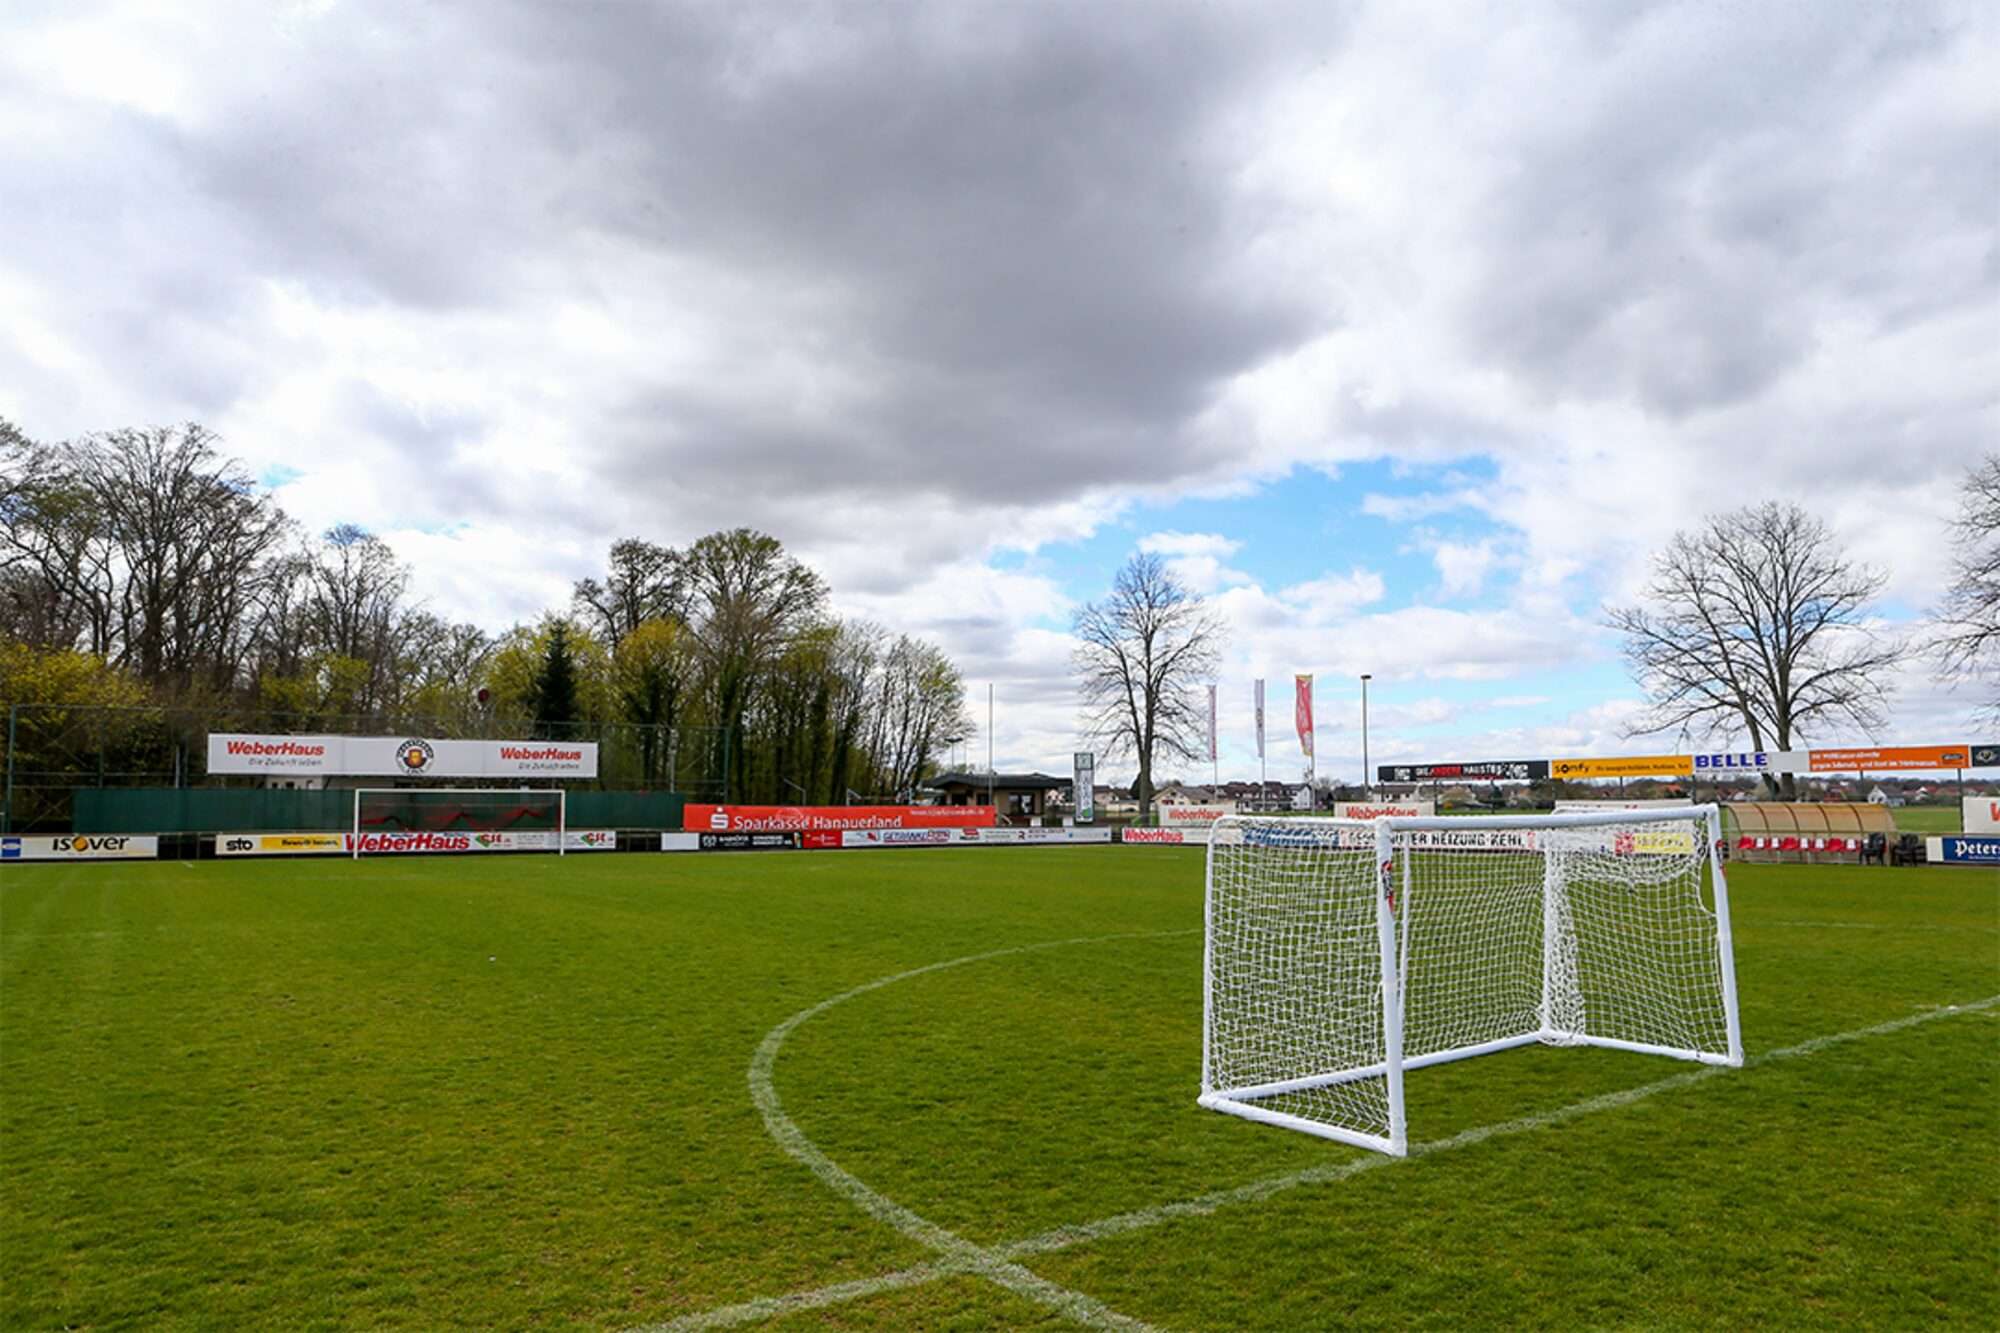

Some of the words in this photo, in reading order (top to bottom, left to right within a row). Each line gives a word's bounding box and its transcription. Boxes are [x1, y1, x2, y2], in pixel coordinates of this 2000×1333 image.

[227, 741, 325, 756] WeberHaus
[500, 747, 582, 761] WeberHaus
[1554, 762, 1589, 774] somfy
[1695, 753, 1768, 768] BELLE
[1168, 808, 1224, 821] WeberHaus
[1345, 805, 1418, 819] WeberHaus
[734, 815, 809, 833] Sparkasse
[813, 814, 903, 830] Hanauerland
[345, 832, 470, 852] WeberHaus
[1124, 828, 1184, 843] WeberHaus
[226, 837, 254, 852] sto
[1955, 840, 2000, 857] Peter
